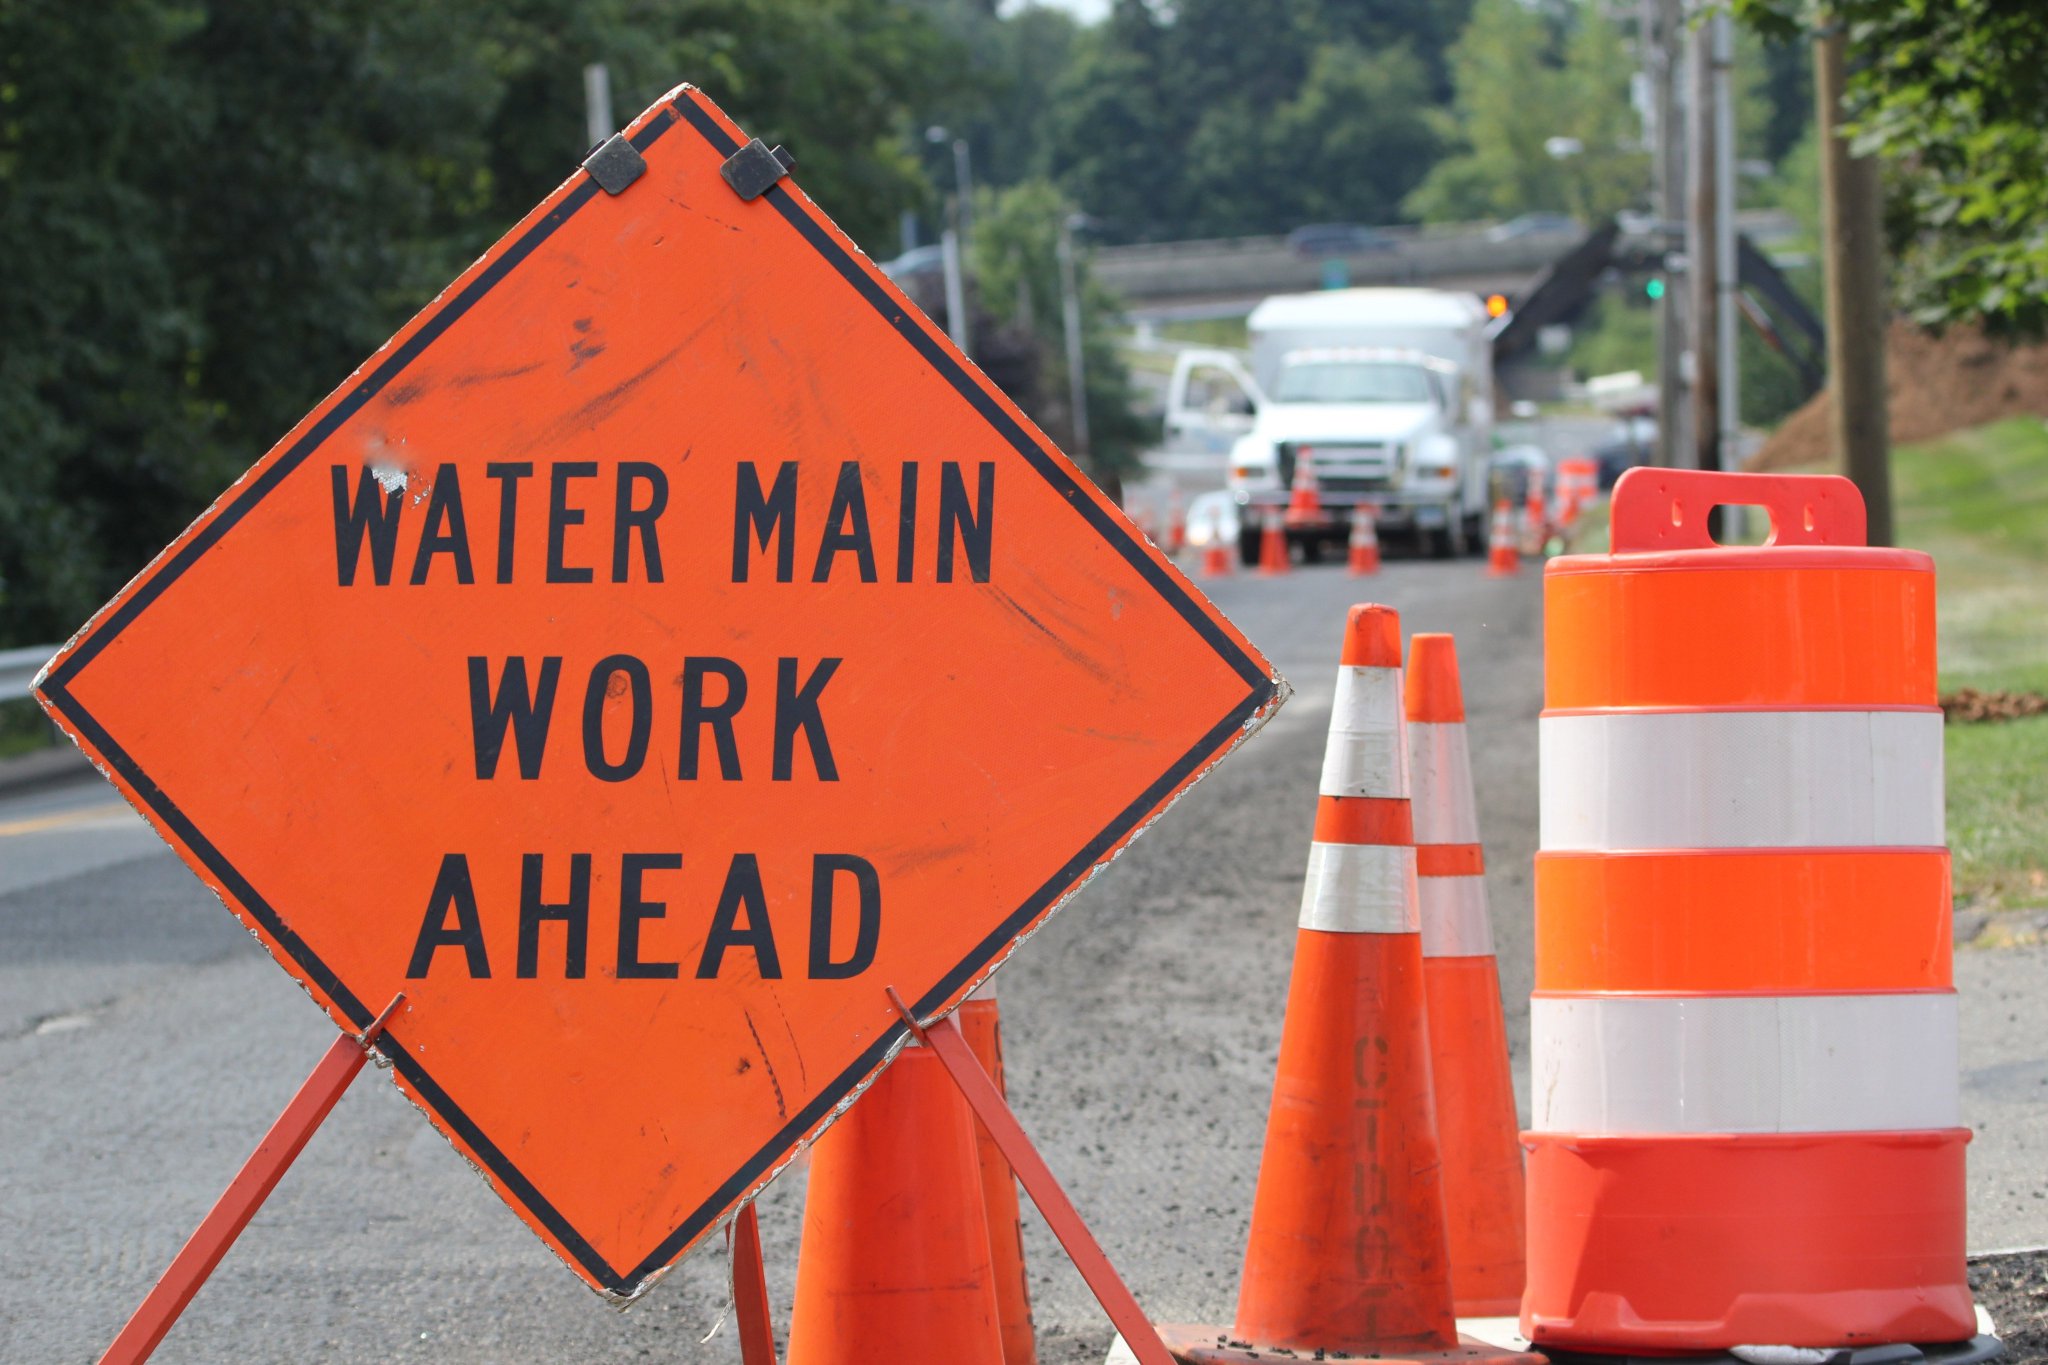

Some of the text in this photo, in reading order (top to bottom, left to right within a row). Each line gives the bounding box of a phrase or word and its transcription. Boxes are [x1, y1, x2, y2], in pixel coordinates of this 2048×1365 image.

[331, 461, 994, 586] WATER MAIN
[468, 654, 842, 782] WORK
[406, 853, 880, 979] AHEAD
